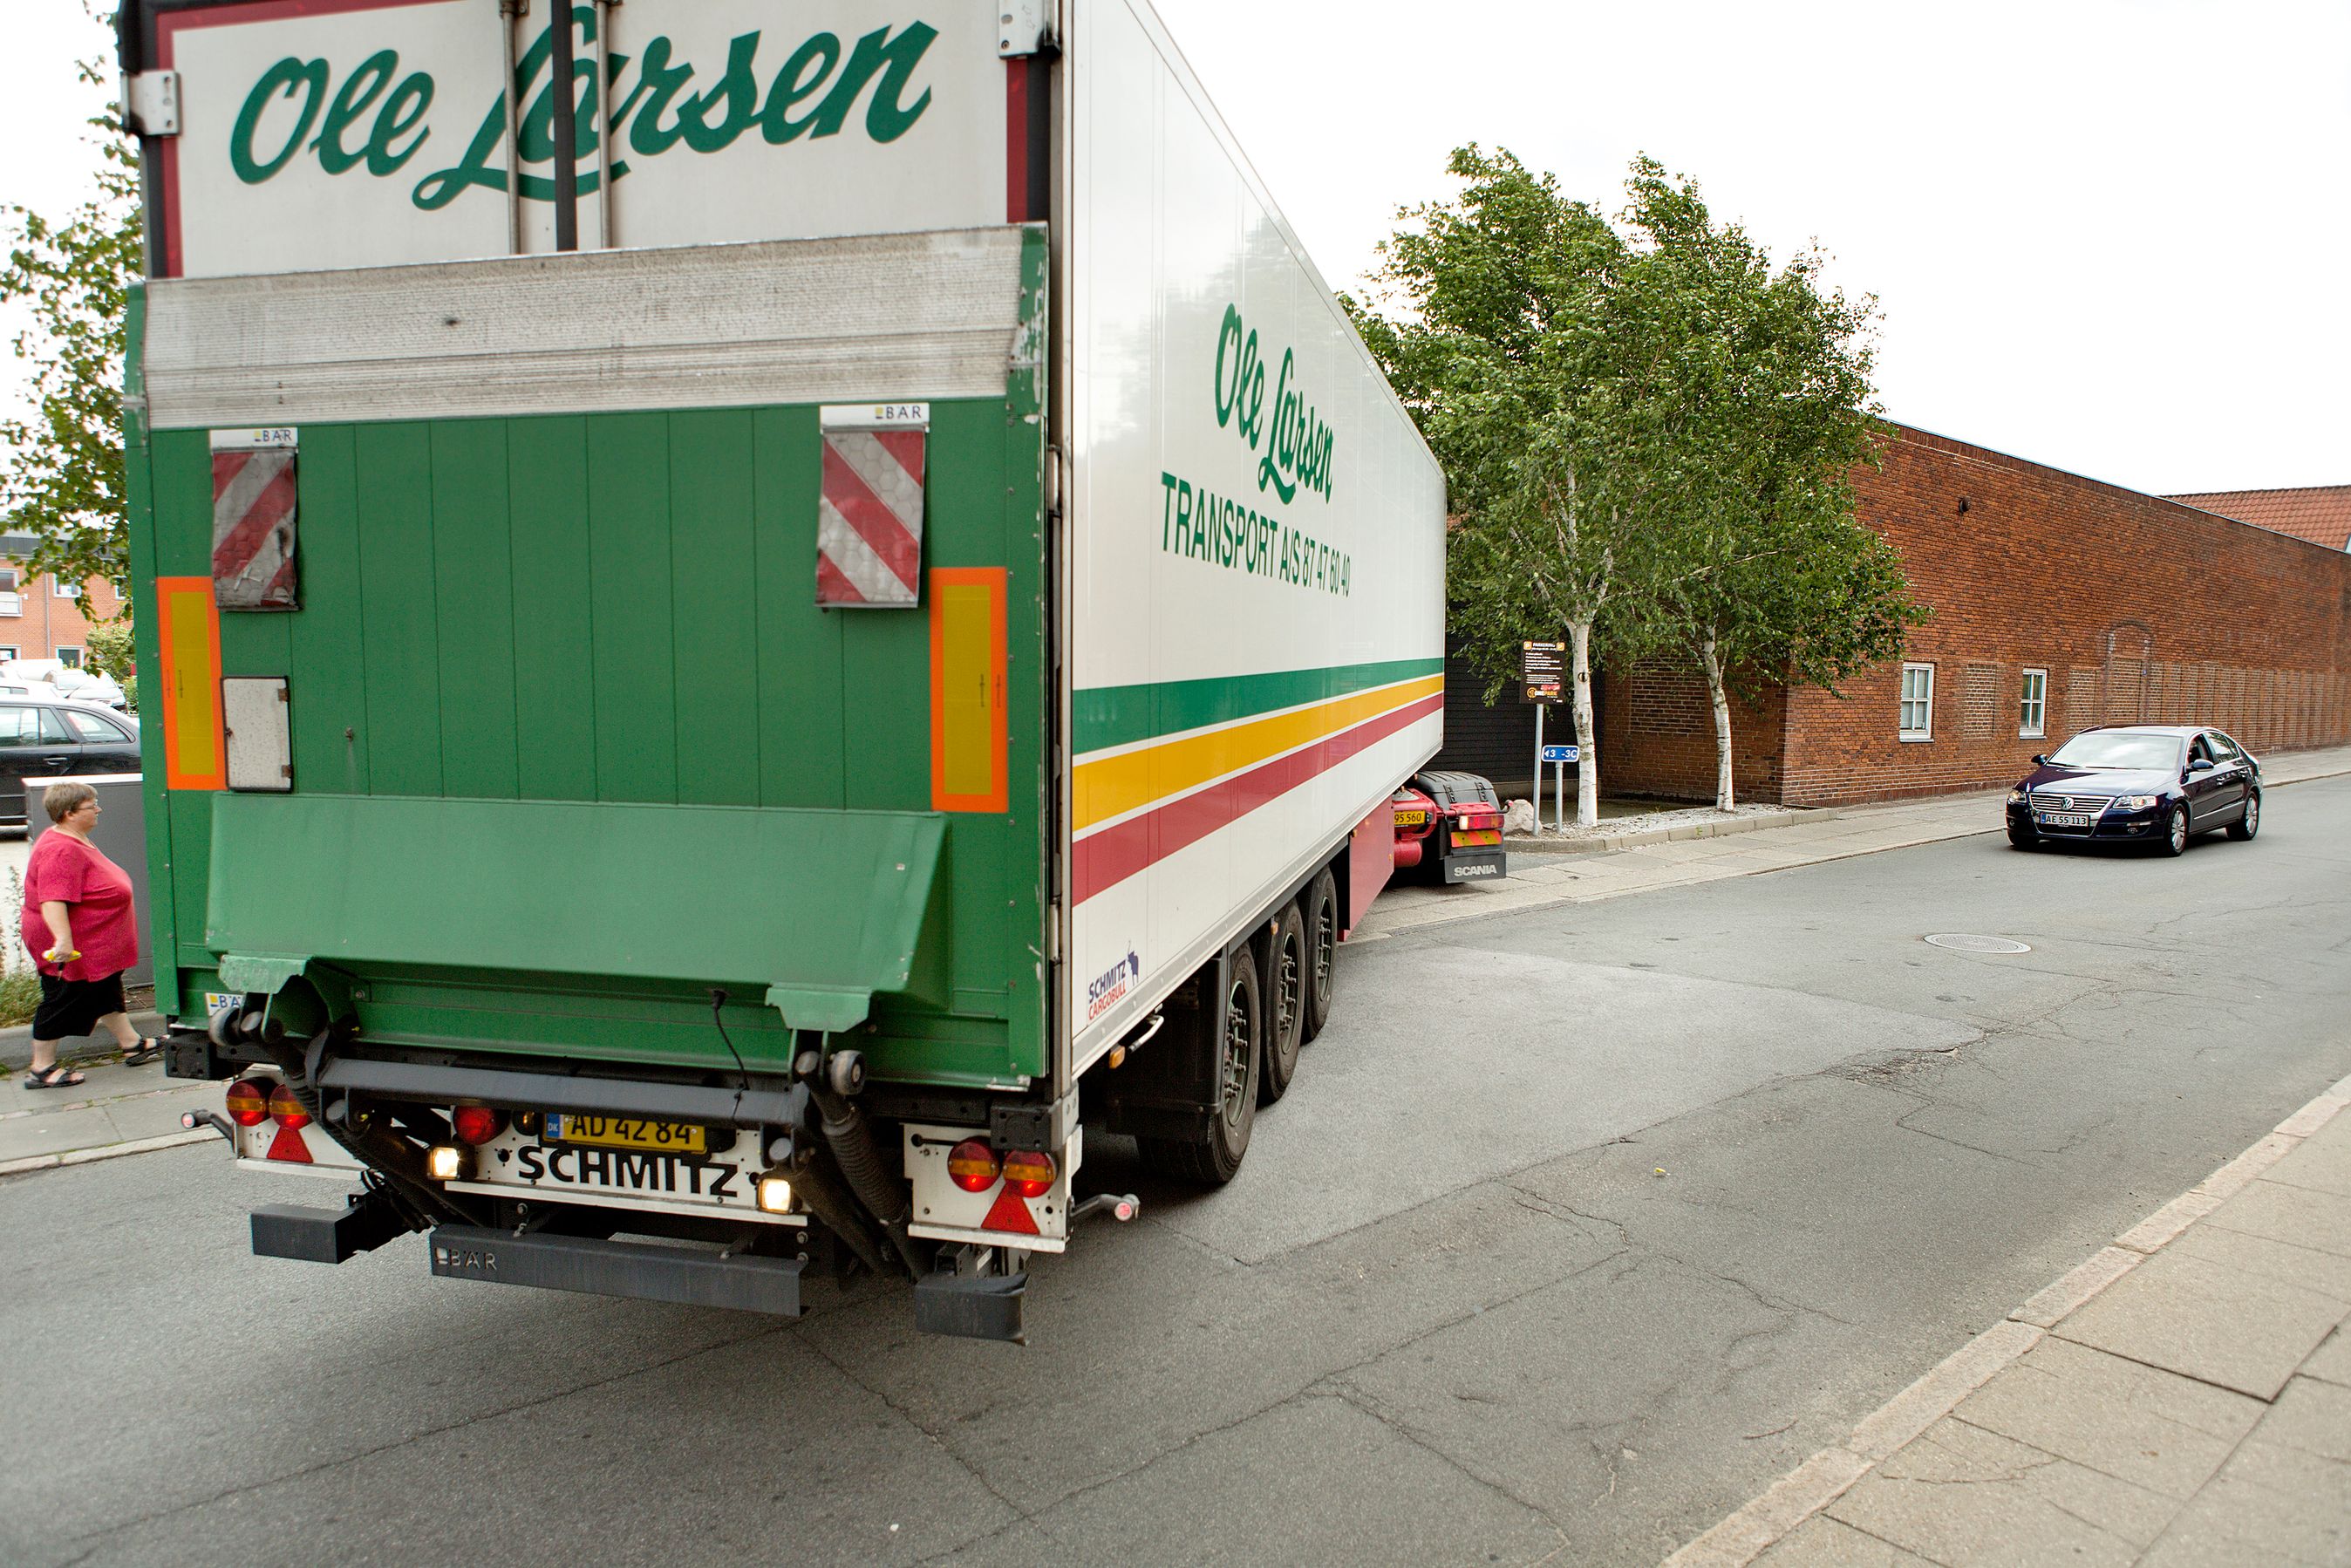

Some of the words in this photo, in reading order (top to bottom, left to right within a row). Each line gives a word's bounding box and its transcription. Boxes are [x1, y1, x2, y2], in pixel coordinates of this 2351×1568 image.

[230, 49, 434, 185] Ole
[412, 5, 939, 211] Larsen
[1216, 303, 1264, 451] Ole
[1258, 346, 1333, 505] Larsen
[1162, 471, 1278, 577] TRANSPORT
[1279, 526, 1300, 585] A/S
[1303, 537, 1315, 588] 87
[1317, 543, 1328, 590] 47
[1330, 549, 1339, 595] 60
[1341, 554, 1350, 597] 40
[1550, 749, 1556, 758] 3
[1394, 814, 1404, 823] 95
[1407, 813, 1421, 822] 560
[2071, 816, 2086, 825] 113
[1454, 864, 1497, 876] SCANIA
[1088, 959, 1126, 1004] SCHMITZ
[219, 995, 241, 1008] BÄ
[1088, 980, 1126, 1020] CARGOBULL
[548, 1122, 558, 1132] DK
[571, 1115, 606, 1136] AD
[518, 1145, 738, 1197] SCHMITZ
